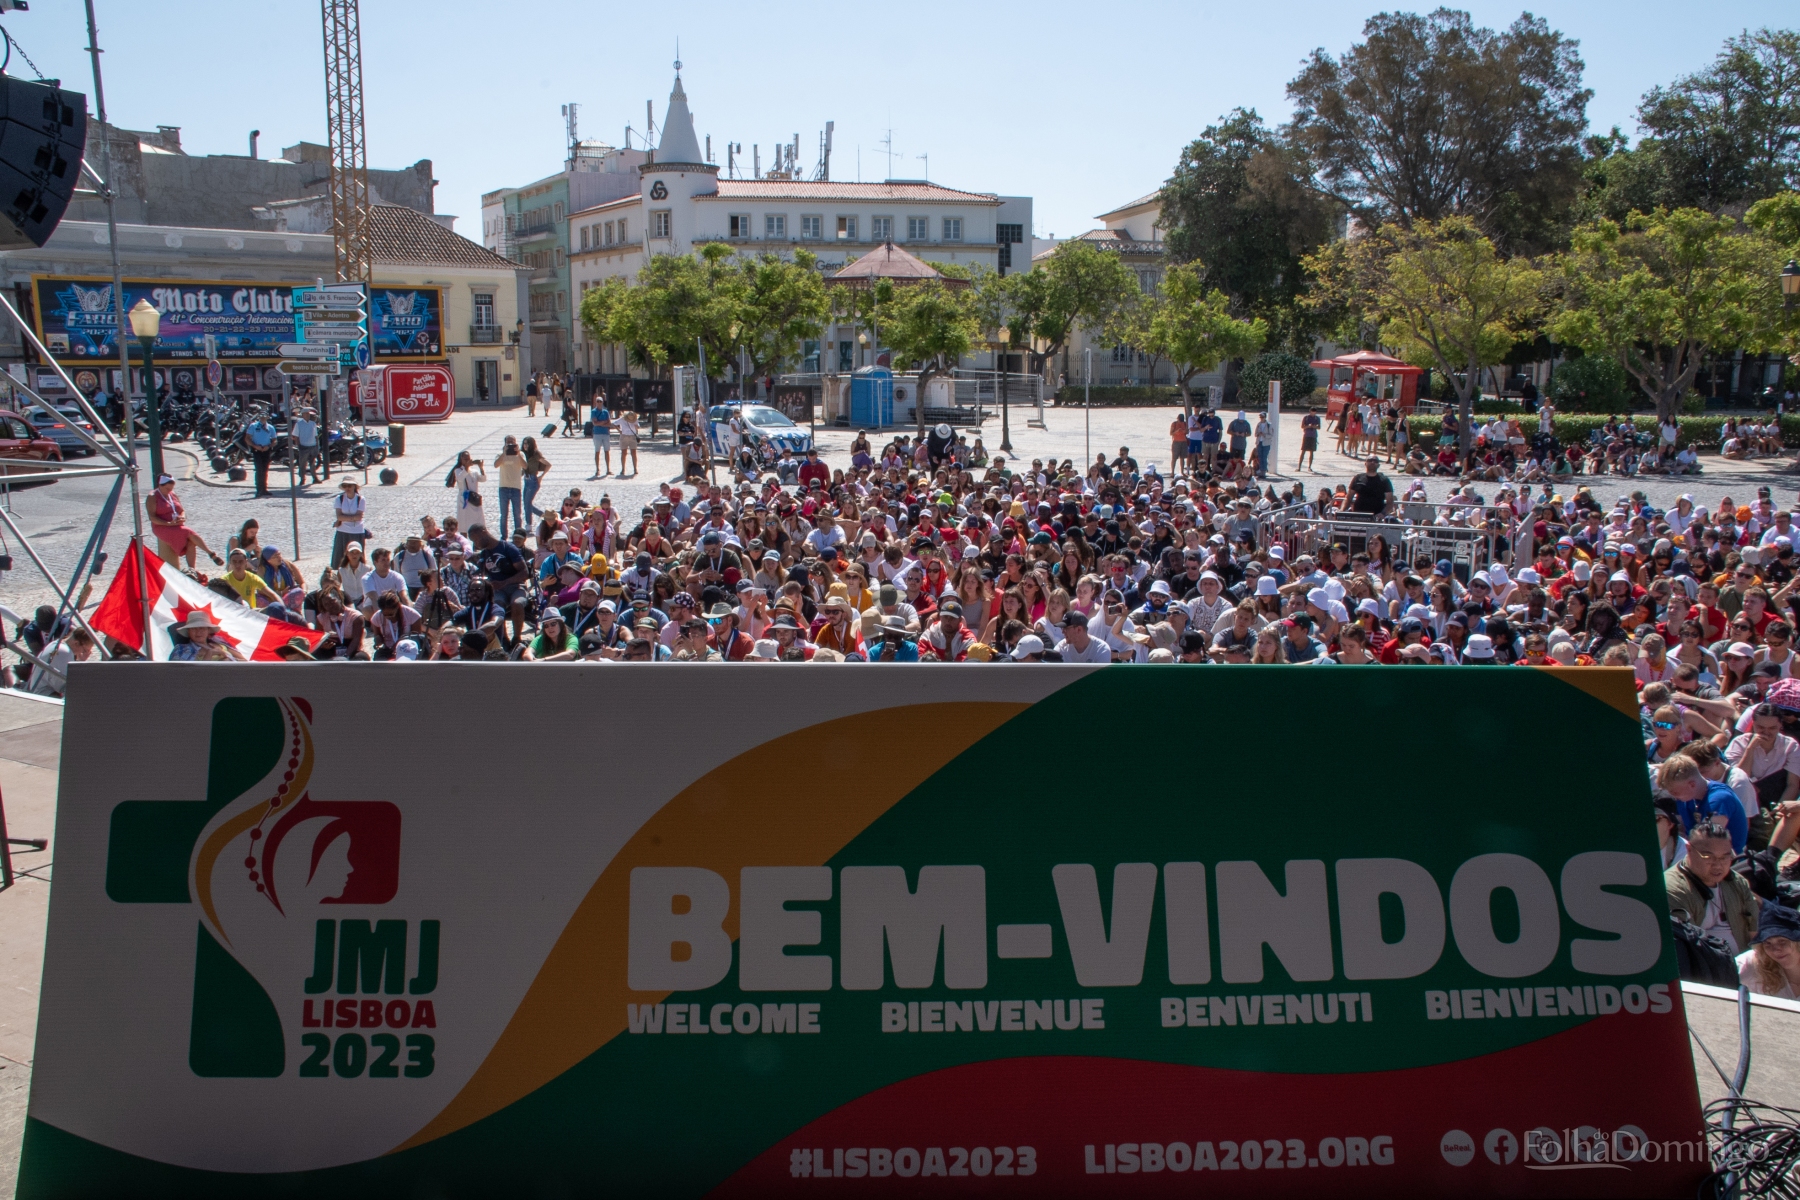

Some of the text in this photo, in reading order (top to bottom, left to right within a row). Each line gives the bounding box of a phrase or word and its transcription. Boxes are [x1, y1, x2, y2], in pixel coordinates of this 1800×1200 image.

[815, 260, 844, 271] Geral
[152, 287, 223, 315] Moto
[189, 313, 245, 325] Concentração
[333, 329, 358, 337] municipal
[381, 314, 421, 328] FARO
[627, 850, 1662, 991] BEM-VINDOS
[304, 918, 441, 995] JMJ
[302, 998, 437, 1029] LISBOA
[627, 983, 1673, 1035] WELCOME BIENVENUE BENVENUTI BIENVENIDOS
[299, 1032, 436, 1079] 2023
[789, 1135, 1395, 1178] #LISBOA2023 LISBOA2023.ORG
